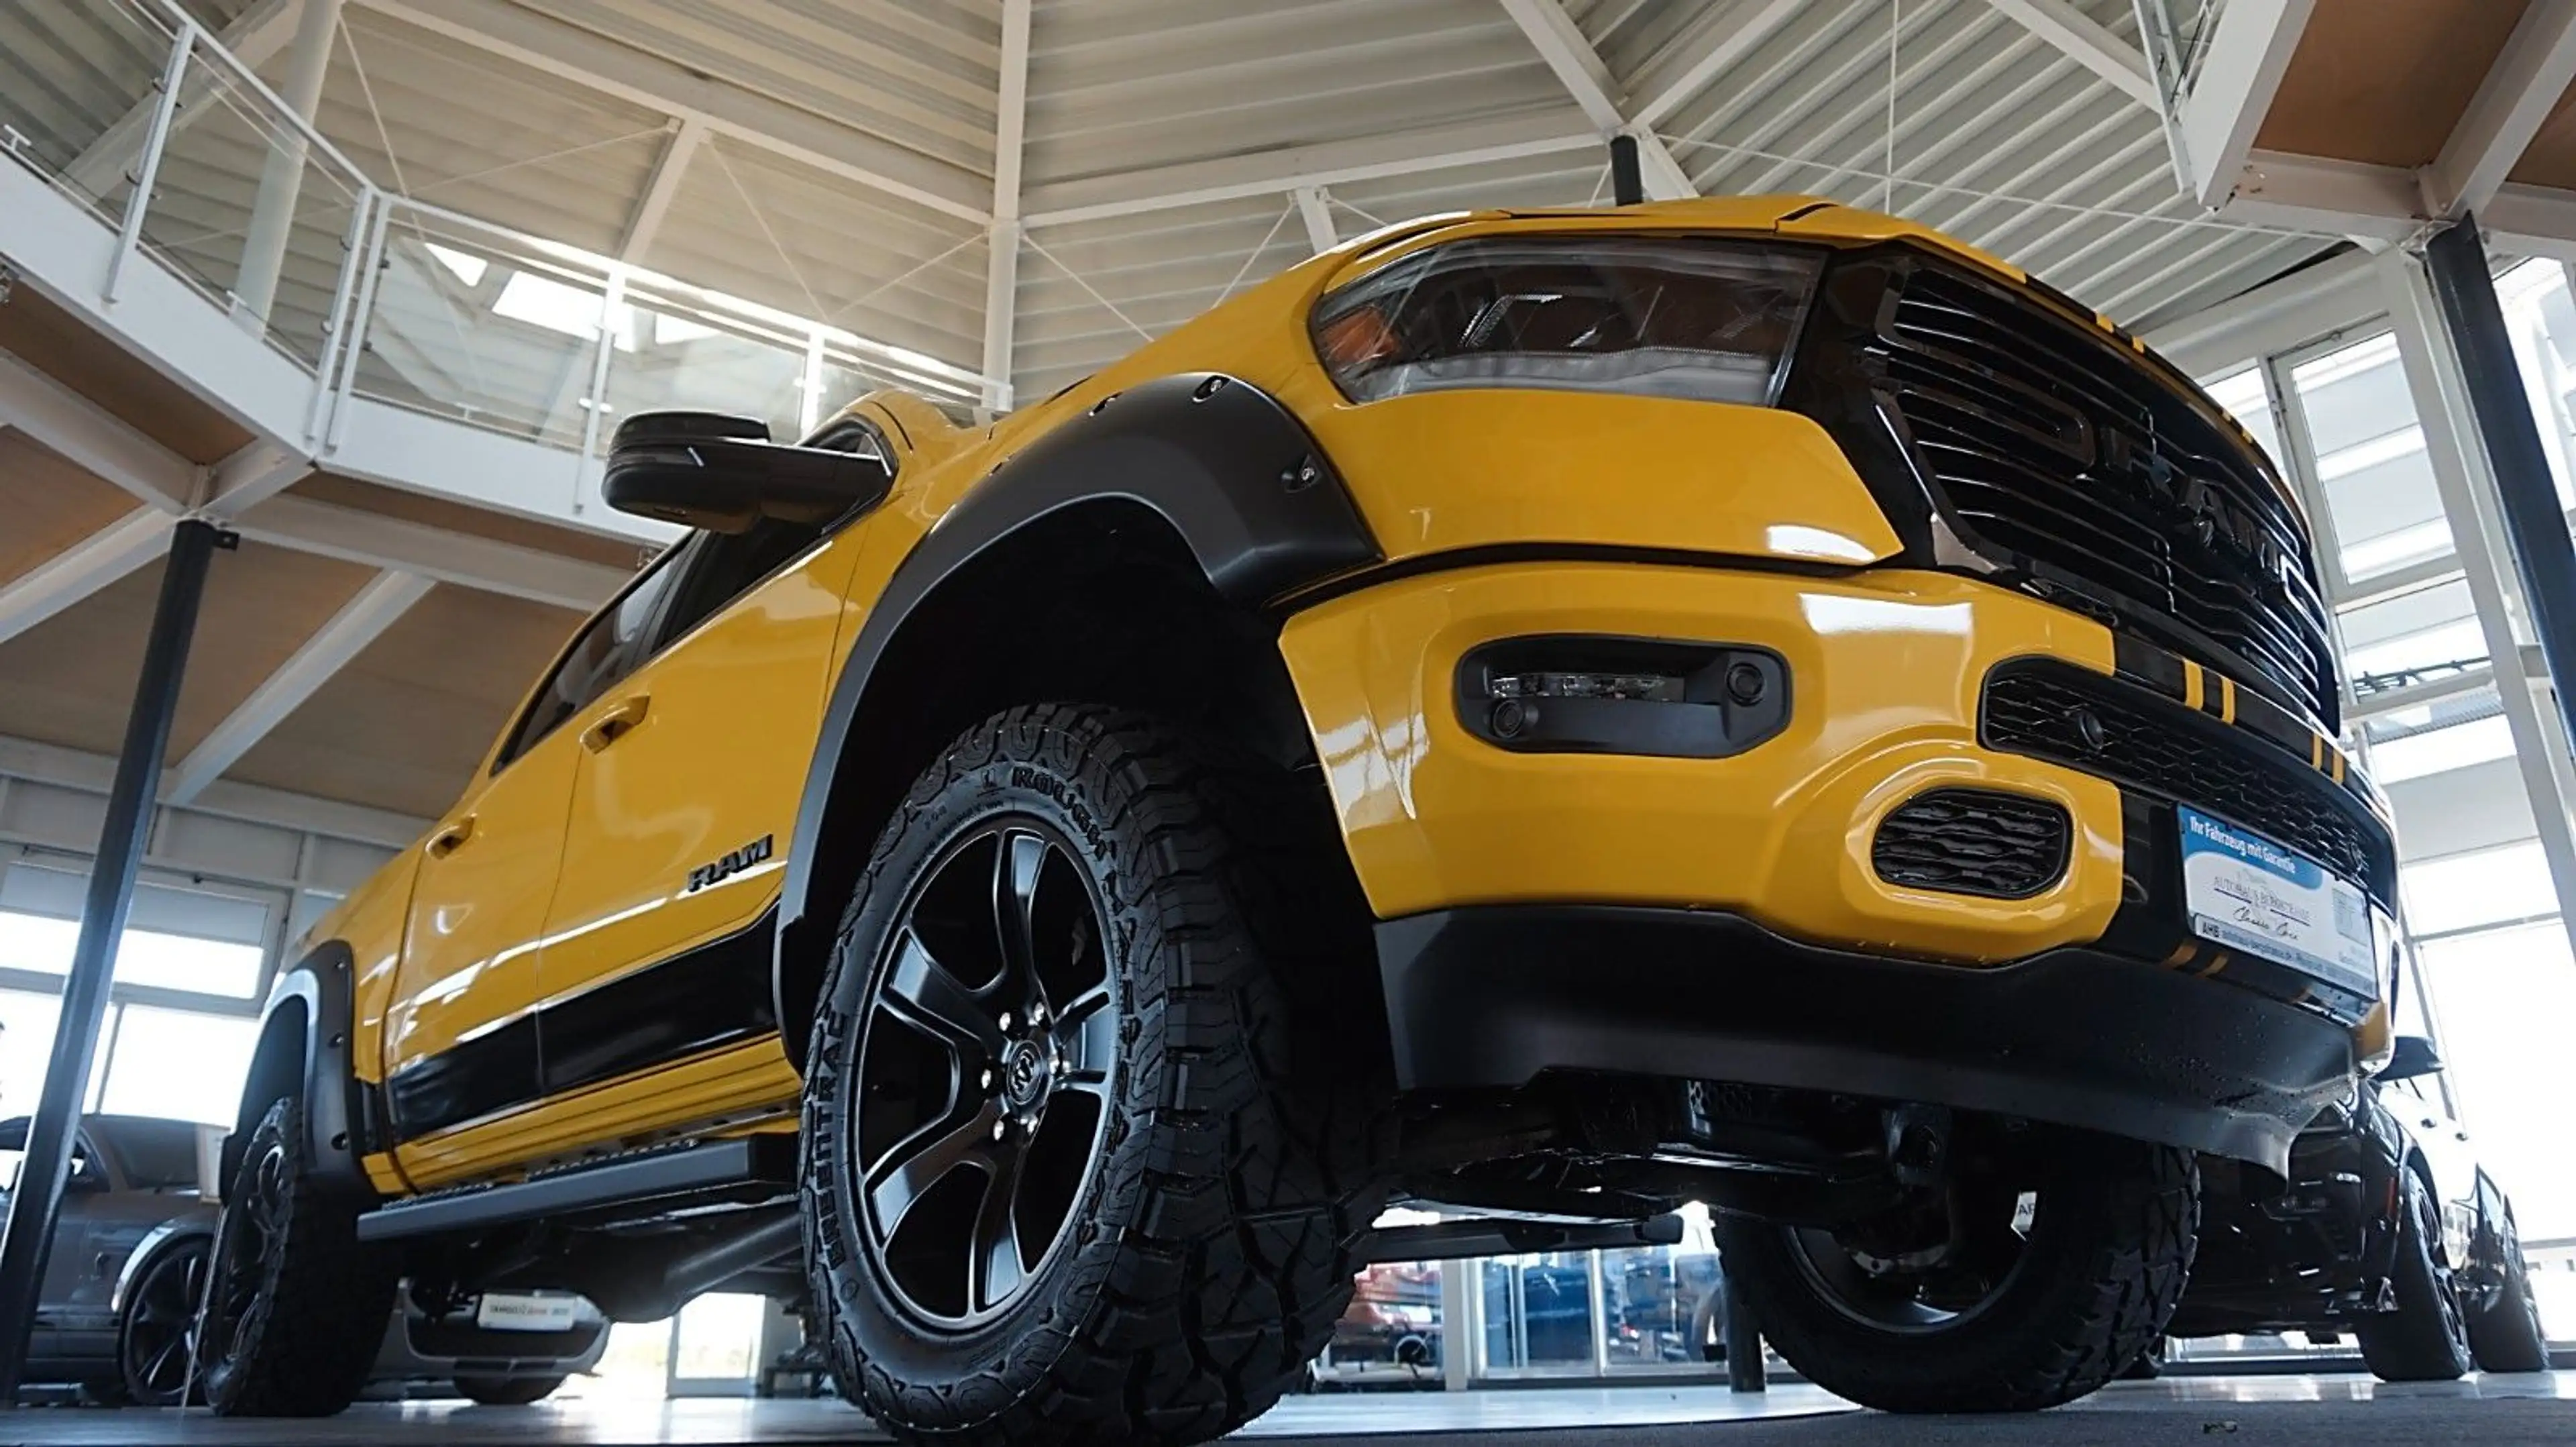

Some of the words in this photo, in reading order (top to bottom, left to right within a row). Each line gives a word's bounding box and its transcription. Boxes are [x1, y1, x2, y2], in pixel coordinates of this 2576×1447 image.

[2100, 425, 2282, 582] RAM
[686, 833, 773, 892] RAM
[2189, 816, 2204, 835] Ihr
[2204, 822, 2247, 857] Fahrzeug
[2247, 843, 2263, 859] mit
